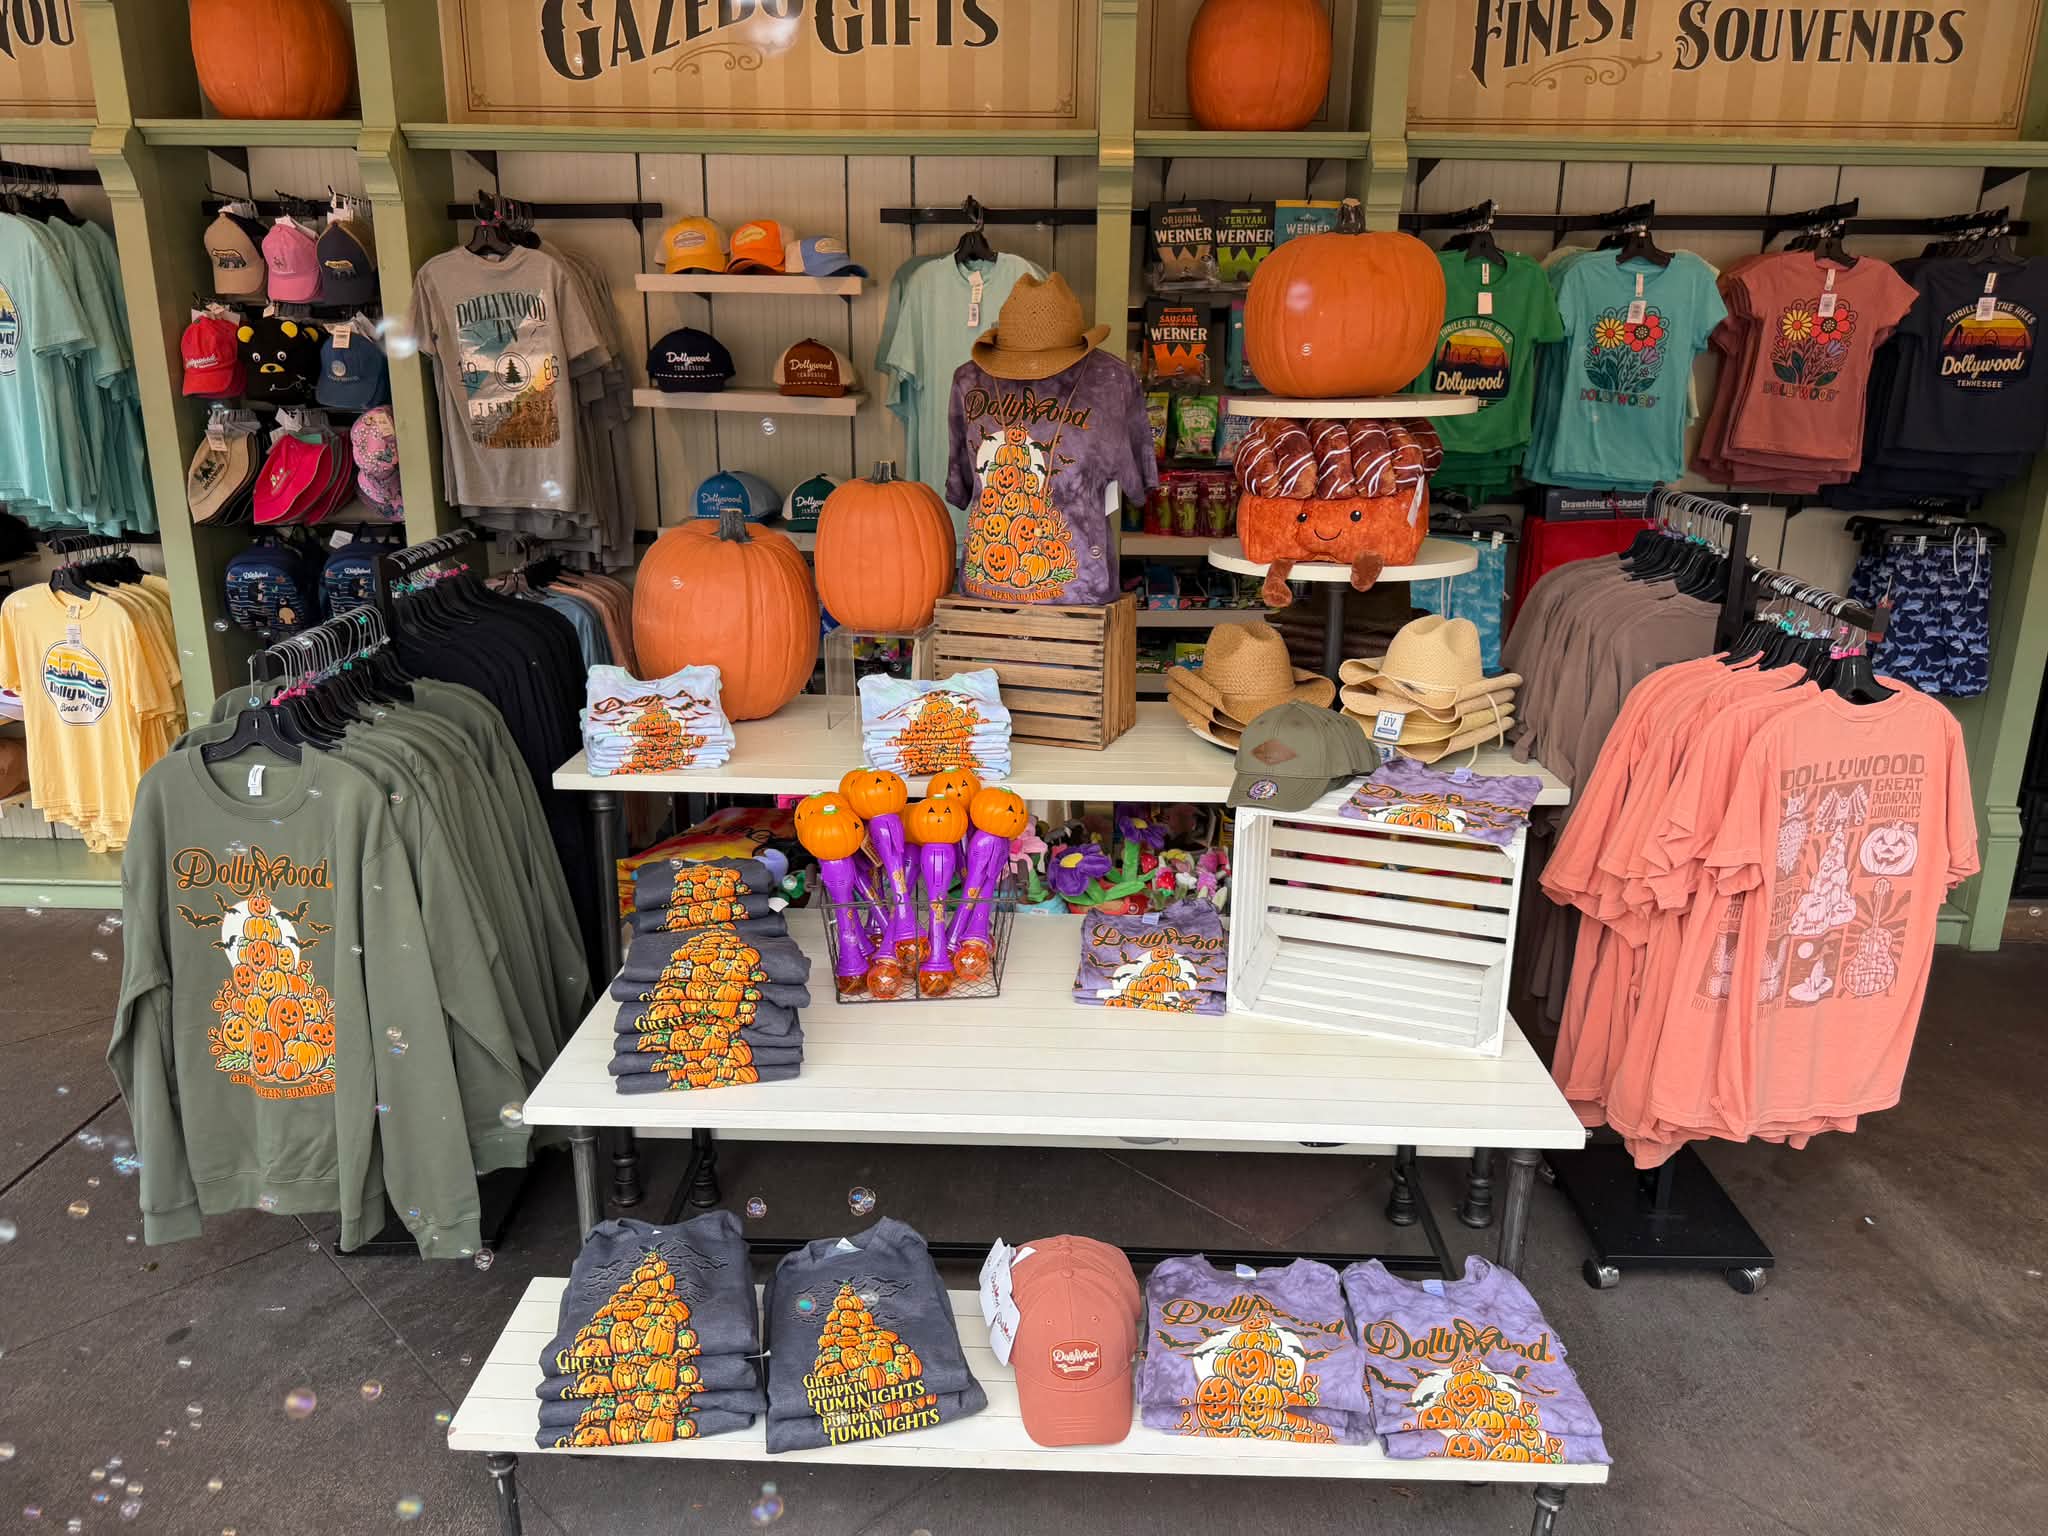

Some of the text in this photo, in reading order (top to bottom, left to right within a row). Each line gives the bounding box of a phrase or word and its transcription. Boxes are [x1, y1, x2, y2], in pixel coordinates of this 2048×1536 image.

[1673, 0, 1967, 71] SOUVENIRS
[1224, 215, 1267, 225] TERIYAKI
[1155, 227, 1213, 243] WERNER
[1215, 229, 1274, 243] WERNER
[456, 292, 547, 329] DOLLYWOOD
[1159, 315, 1198, 323] SAUSAGE
[1946, 303, 1979, 324] THRILL
[1996, 301, 2015, 312] THE
[493, 319, 520, 343] TN
[1151, 327, 1208, 342] WERNER
[543, 355, 560, 381] 86
[666, 352, 712, 367] Dollywood
[789, 359, 833, 373] Dollywood
[1941, 351, 2025, 379] Dollywood
[1435, 370, 1505, 397] Dollywood
[1957, 379, 2004, 388] TENNESSEE
[702, 492, 744, 506] Dollywood
[1383, 716, 1397, 728] UV
[1780, 753, 1925, 791] DOLLYWOOD
[1875, 777, 1923, 792] GREAT
[1872, 791, 1922, 805] PUMPKIN
[634, 1014, 686, 1033] GREAT
[556, 1348, 612, 1371] GREAT
[803, 1373, 848, 1389] GREAT
[807, 1380, 869, 1406] PUMPKIN
[814, 1379, 926, 1415] LUMINIGHTS
[822, 1409, 883, 1434] PUMPKIN
[829, 1408, 941, 1446] LUMINIGHTS
